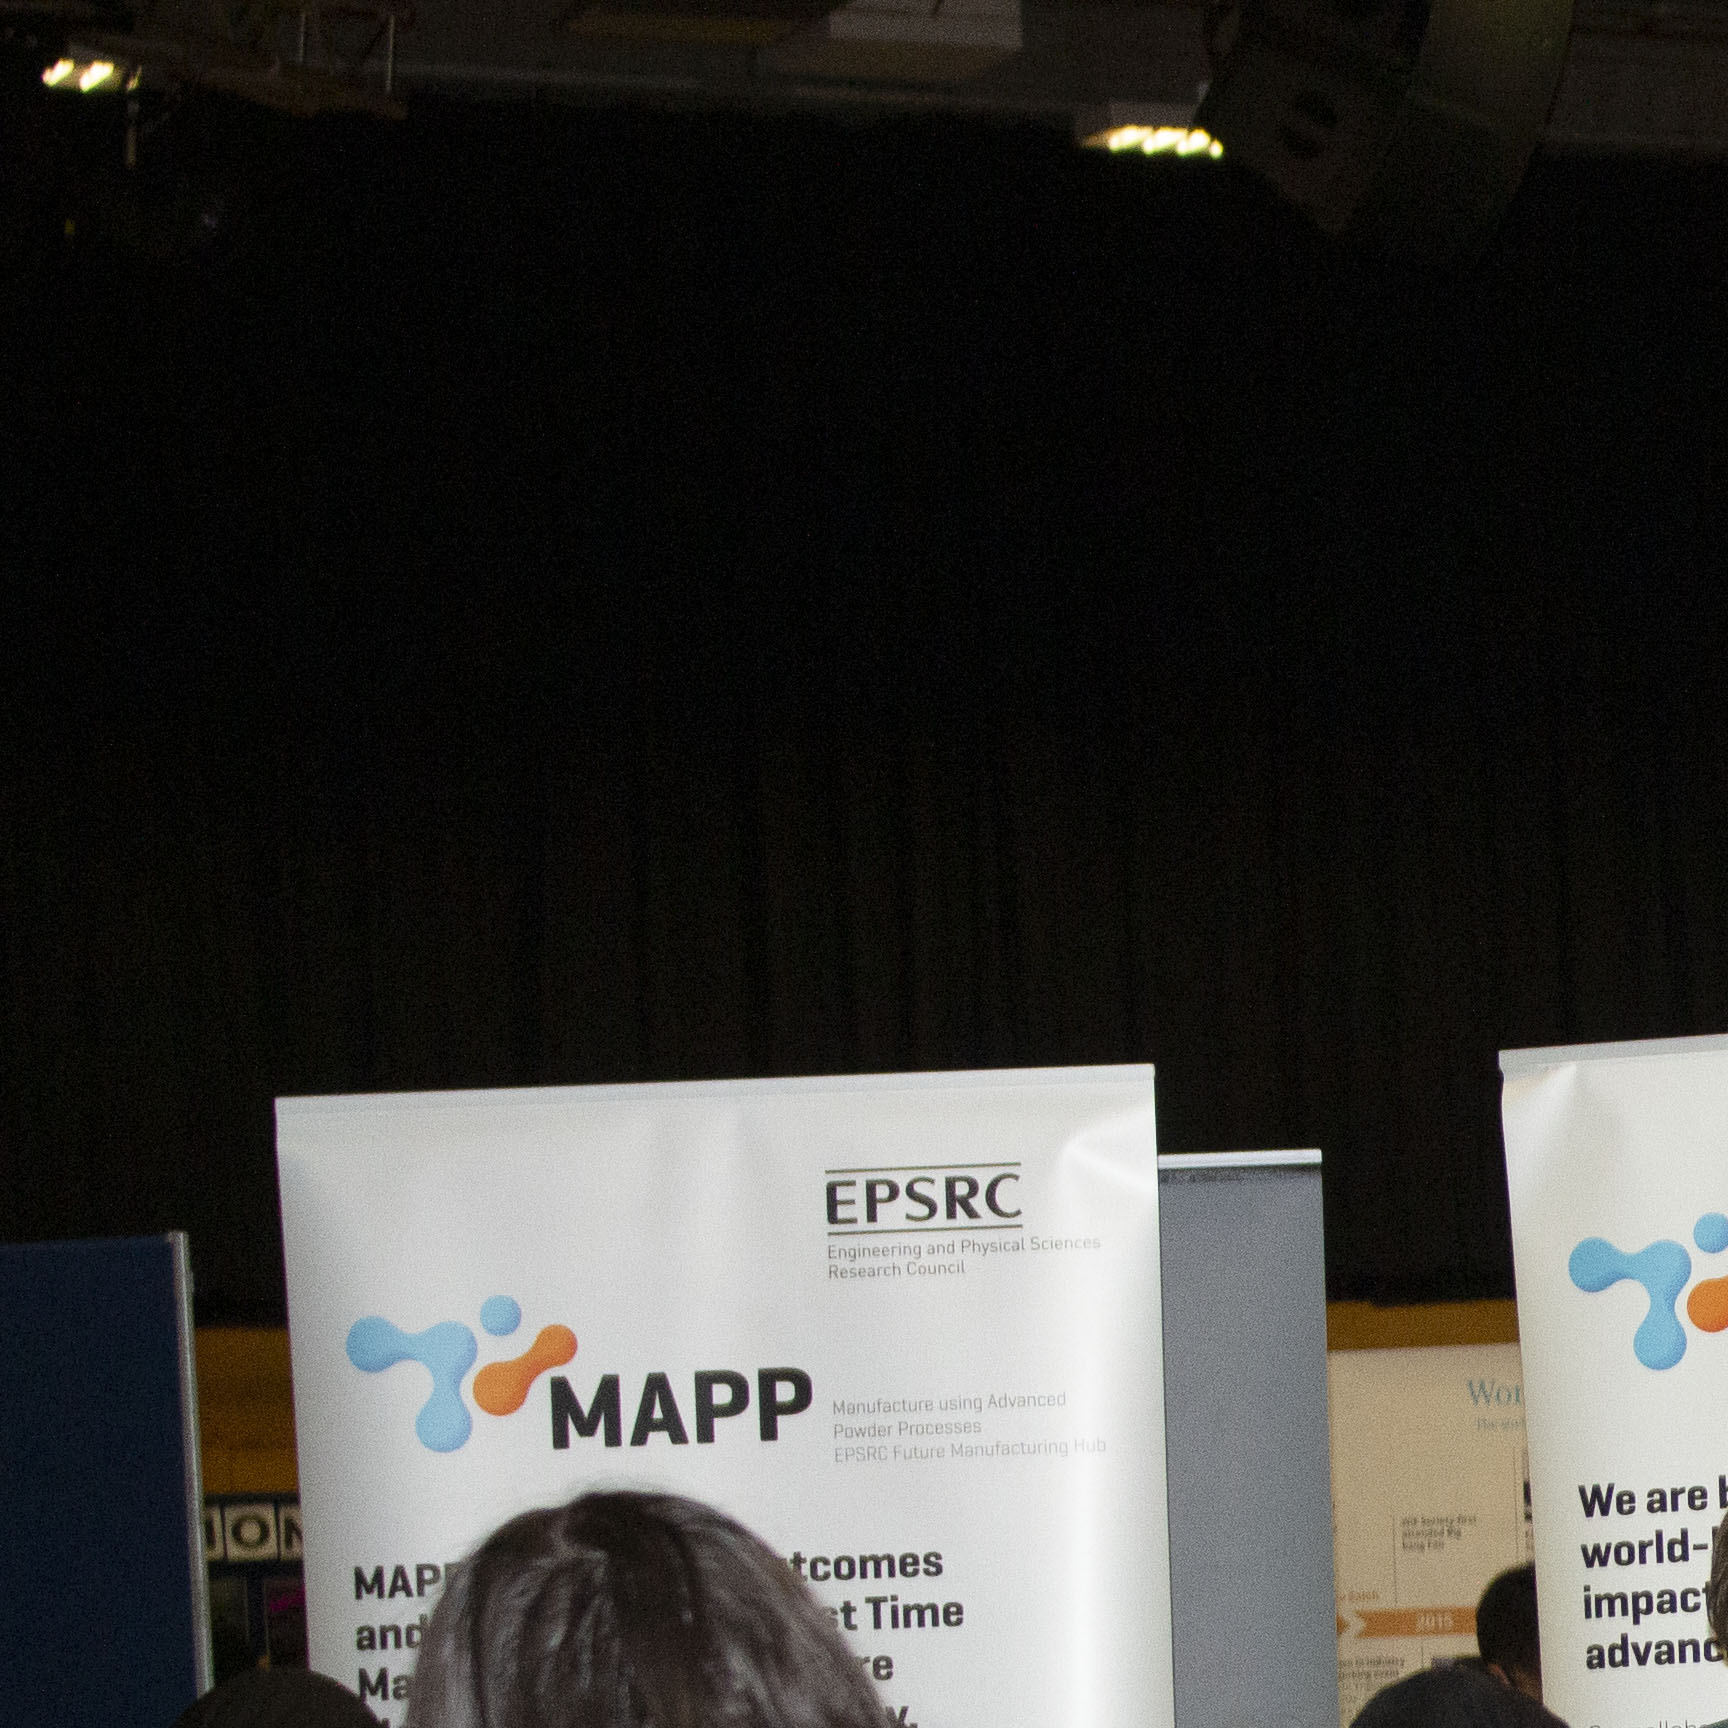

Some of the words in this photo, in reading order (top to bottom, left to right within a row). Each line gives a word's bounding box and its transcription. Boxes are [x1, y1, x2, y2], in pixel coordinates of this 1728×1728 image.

[826, 1173, 1022, 1225] EPSRC
[828, 1242, 922, 1262] Engineering
[927, 1240, 955, 1255] and
[961, 1237, 1026, 1257] Physical
[1030, 1236, 1101, 1251] Sciences
[828, 1261, 901, 1279] Research
[906, 1259, 966, 1275] Council
[549, 1367, 814, 1450] MAPP
[832, 1397, 934, 1416] Manufacture
[938, 1395, 983, 1414] using
[987, 1391, 1067, 1410] Advanced
[833, 1422, 894, 1439] Powder
[898, 1418, 982, 1436] Processes
[834, 1445, 889, 1464] EPSRC
[893, 1443, 946, 1461] Future
[950, 1437, 1069, 1460] Manufacturing
[1073, 1436, 1107, 1454] Hub
[1578, 1483, 1636, 1518] We
[1646, 1485, 1708, 1513] are
[1581, 1526, 1719, 1568] world-
[865, 1594, 964, 1630] Time
